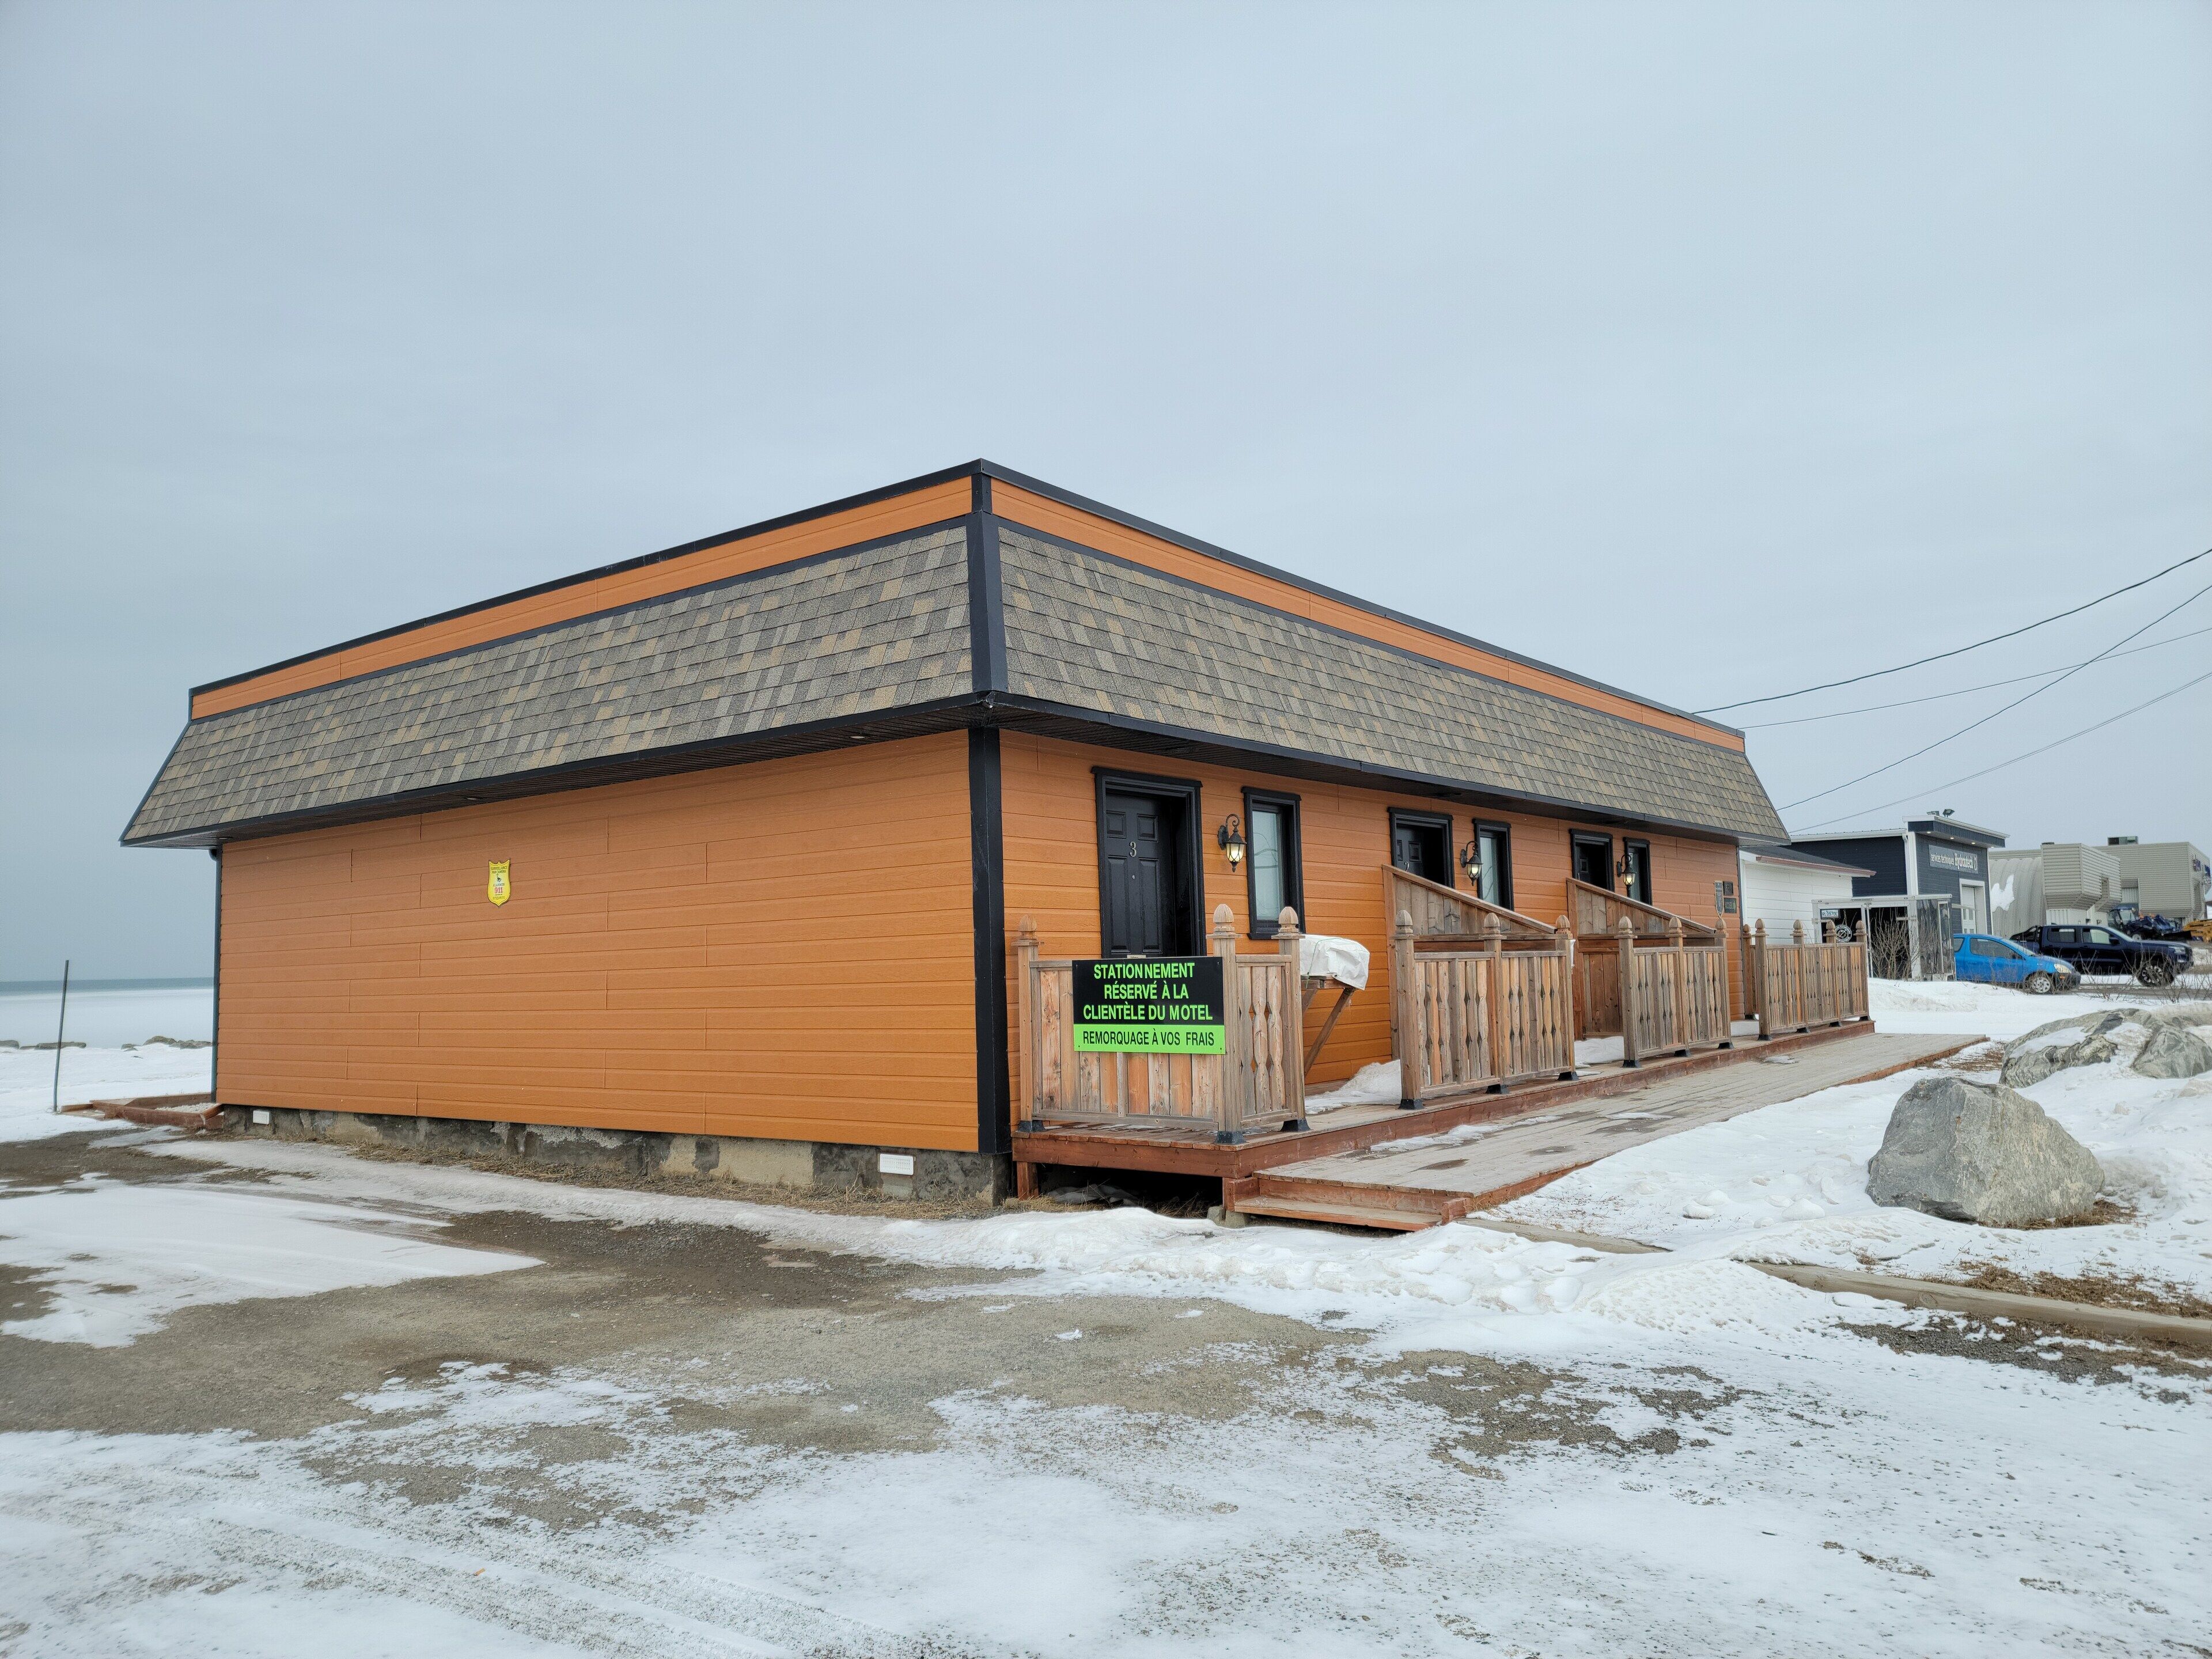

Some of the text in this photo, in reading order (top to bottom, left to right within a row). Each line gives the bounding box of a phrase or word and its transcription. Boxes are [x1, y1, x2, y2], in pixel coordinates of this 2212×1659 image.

[1129, 841, 1137, 857] 3
[1930, 853, 1941, 863] services
[1094, 963, 1195, 979] STATIONNEMENT
[1104, 980, 1189, 999] RÉSERVÉ À LA
[1083, 1001, 1213, 1020] CLIENTÈLE DU MOTEL
[1082, 1028, 1214, 1046] REMORQUAGE À VOS FRAIS
